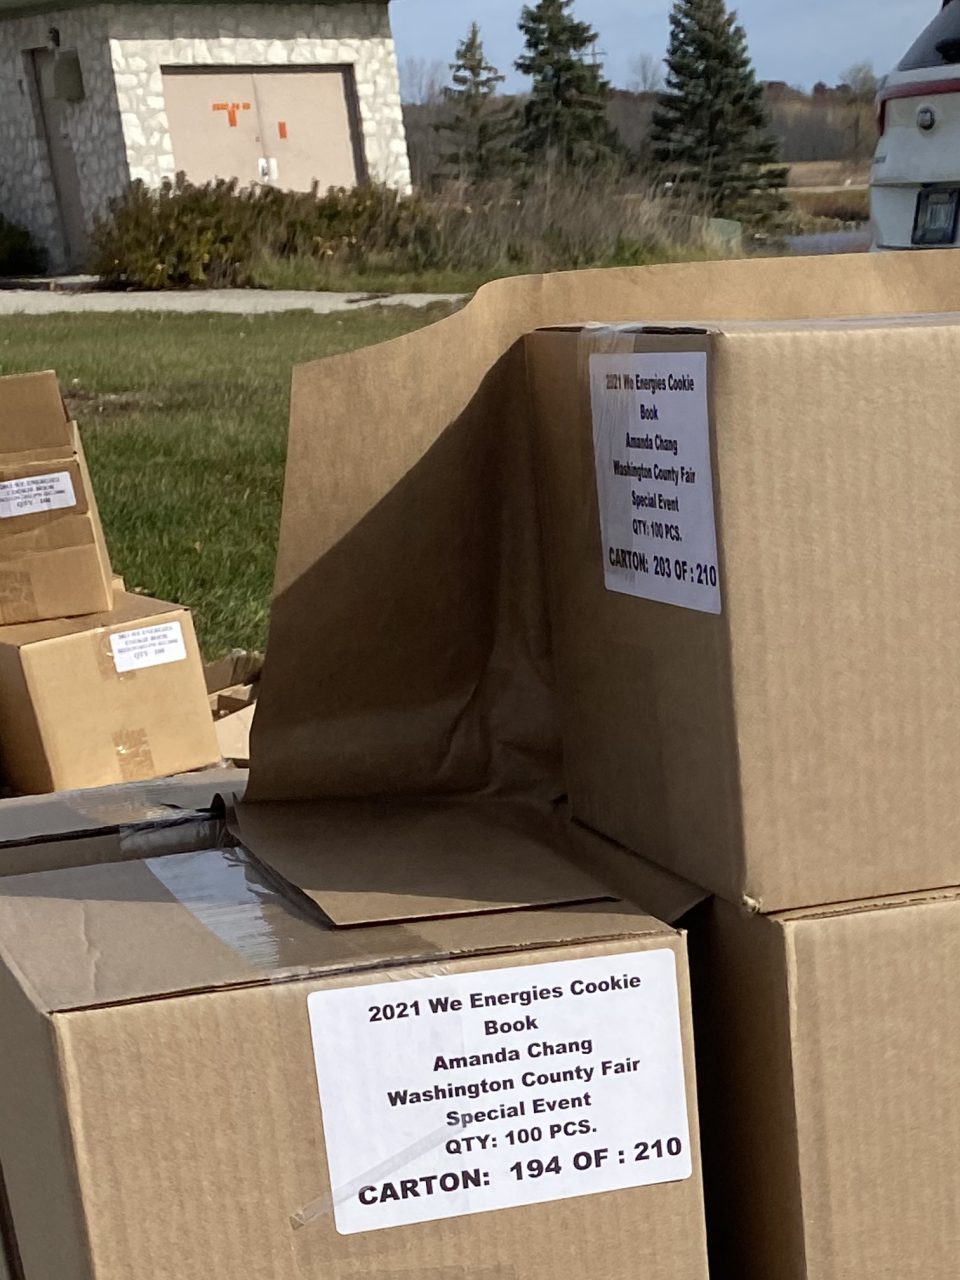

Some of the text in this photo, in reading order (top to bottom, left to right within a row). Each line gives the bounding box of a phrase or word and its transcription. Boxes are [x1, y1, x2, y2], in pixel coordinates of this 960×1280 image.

[605, 374, 694, 394] 2021 We Energies Cookie
[639, 404, 658, 420] Book
[625, 432, 677, 454] Amanda Chang
[613, 460, 695, 485] Washington County Fair
[631, 491, 679, 511] Special Event
[632, 519, 681, 541] QTY: 100 PCS.
[608, 547, 648, 573] CARTON:
[653, 555, 671, 577] 203
[696, 563, 716, 586] 210
[368, 973, 641, 1023] 2021 We Energies Cookie
[483, 1014, 539, 1036] Book
[433, 1039, 593, 1072] Amanda Chang
[386, 1057, 641, 1107] Washington County Fair
[446, 1091, 592, 1129] Special Event
[445, 1119, 597, 1155] QTY: 100 PCS.
[358, 1168, 490, 1206] CARTON:
[509, 1155, 562, 1181] 194
[633, 1136, 682, 1162] 210
